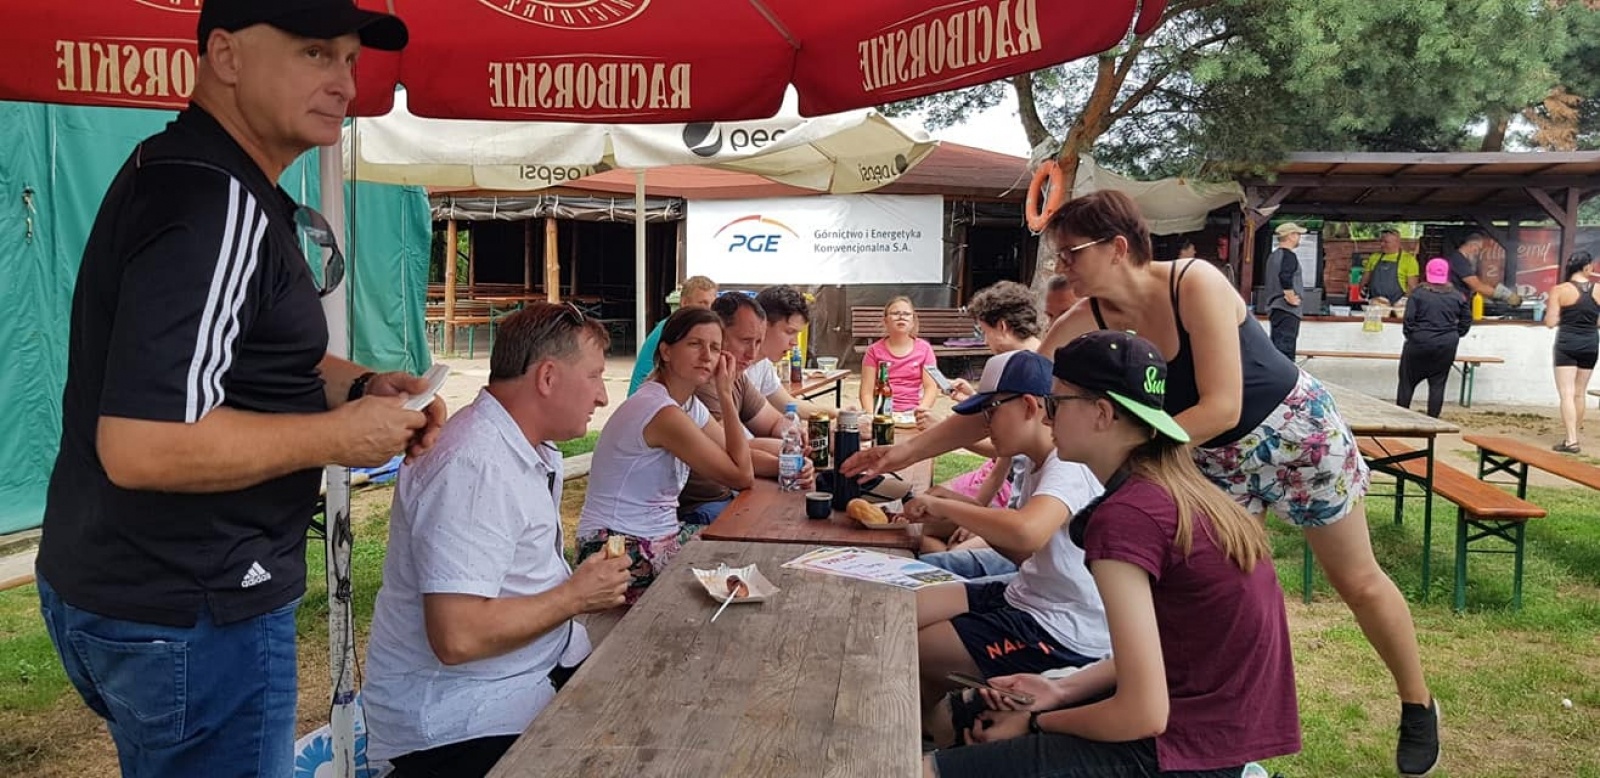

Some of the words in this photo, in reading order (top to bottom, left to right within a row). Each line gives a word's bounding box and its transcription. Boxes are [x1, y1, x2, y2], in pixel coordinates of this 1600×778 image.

[814, 229, 863, 239] Górnictwo
[871, 229, 921, 240] Energetyka
[729, 235, 781, 252] PGE
[814, 243, 890, 253] Konwencjonalna
[893, 242, 912, 252] S.A.
